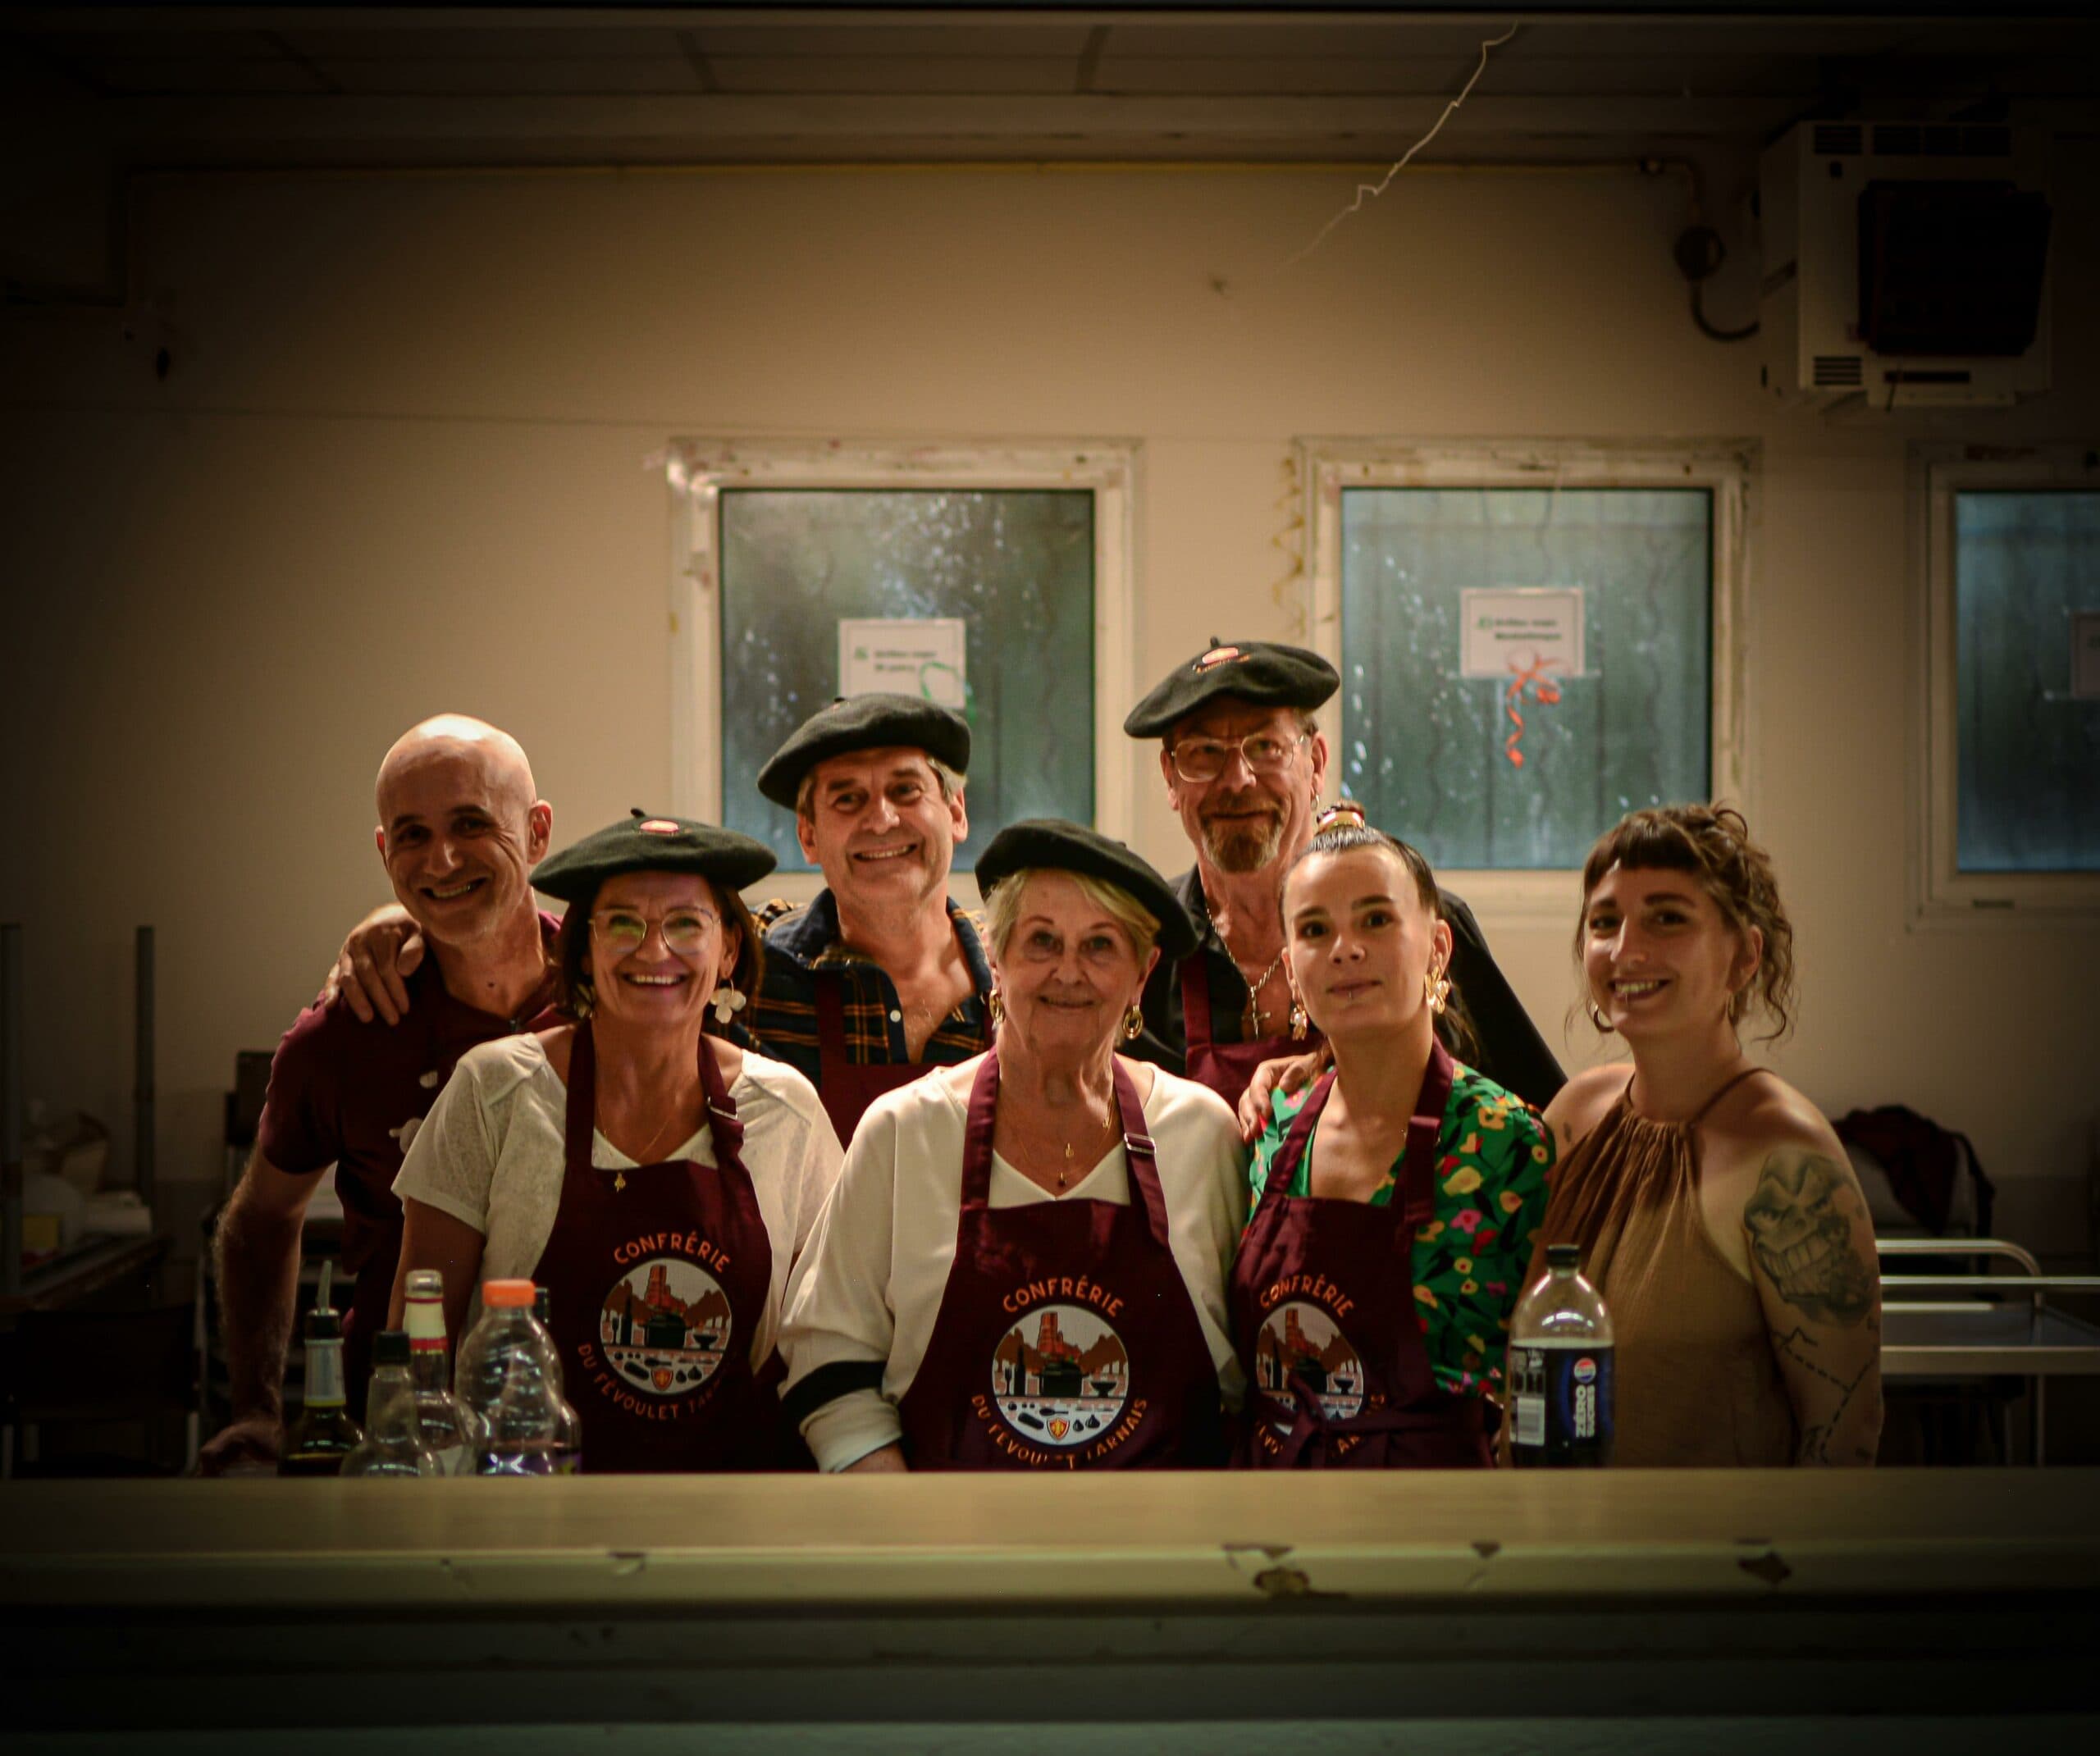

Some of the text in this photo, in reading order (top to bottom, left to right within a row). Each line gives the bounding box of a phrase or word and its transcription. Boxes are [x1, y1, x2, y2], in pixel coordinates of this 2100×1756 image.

[614, 1230, 731, 1273] CONFRÉRIE
[1003, 1275, 1124, 1318] CONFRÉRIE
[1260, 1274, 1355, 1318] CONFRÉRIE
[578, 1343, 597, 1369] DU
[971, 1395, 991, 1419] DU
